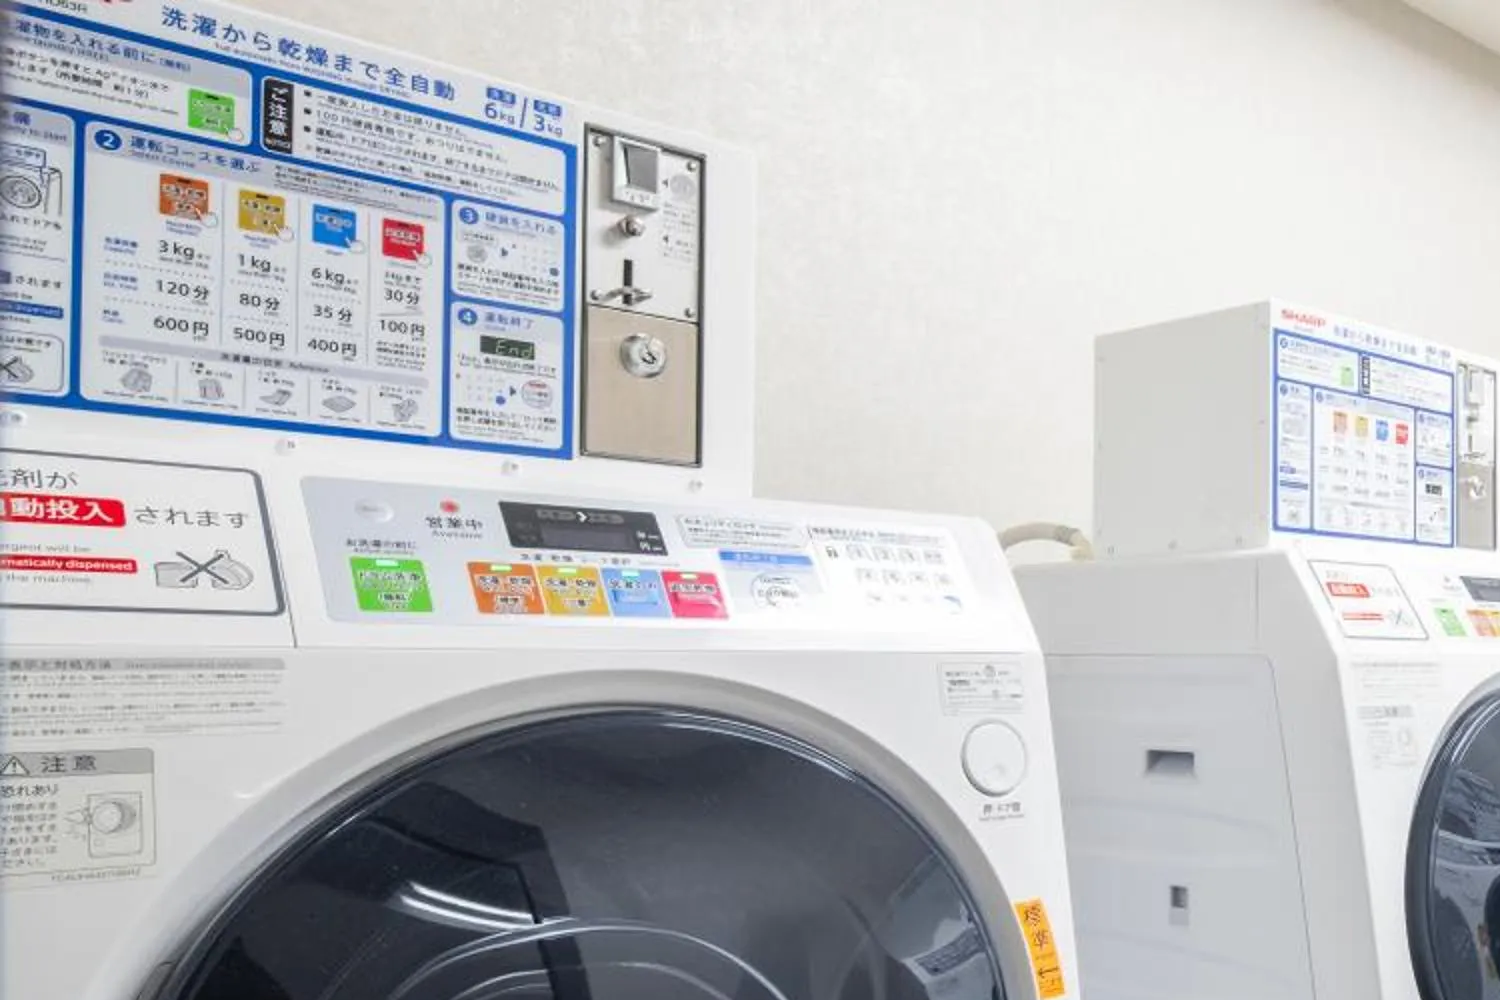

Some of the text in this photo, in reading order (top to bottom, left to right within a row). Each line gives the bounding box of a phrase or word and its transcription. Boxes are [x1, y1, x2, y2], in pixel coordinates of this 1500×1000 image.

[160, 4, 455, 102] 洗濯から乾燥まで全自動
[102, 131, 116, 149] 2
[130, 135, 261, 173] 運転コースを選ぶ
[157, 280, 210, 301] 120分
[384, 288, 420, 305] 30分
[239, 293, 280, 311] 80分
[313, 303, 353, 323] 35分
[154, 316, 209, 337] 600円
[233, 326, 285, 347] 500円
[379, 319, 426, 338] 100円
[308, 338, 357, 357] 400円
[0, 469, 79, 489] 剤が
[134, 506, 249, 529] されます
[41, 754, 97, 773] 注意
